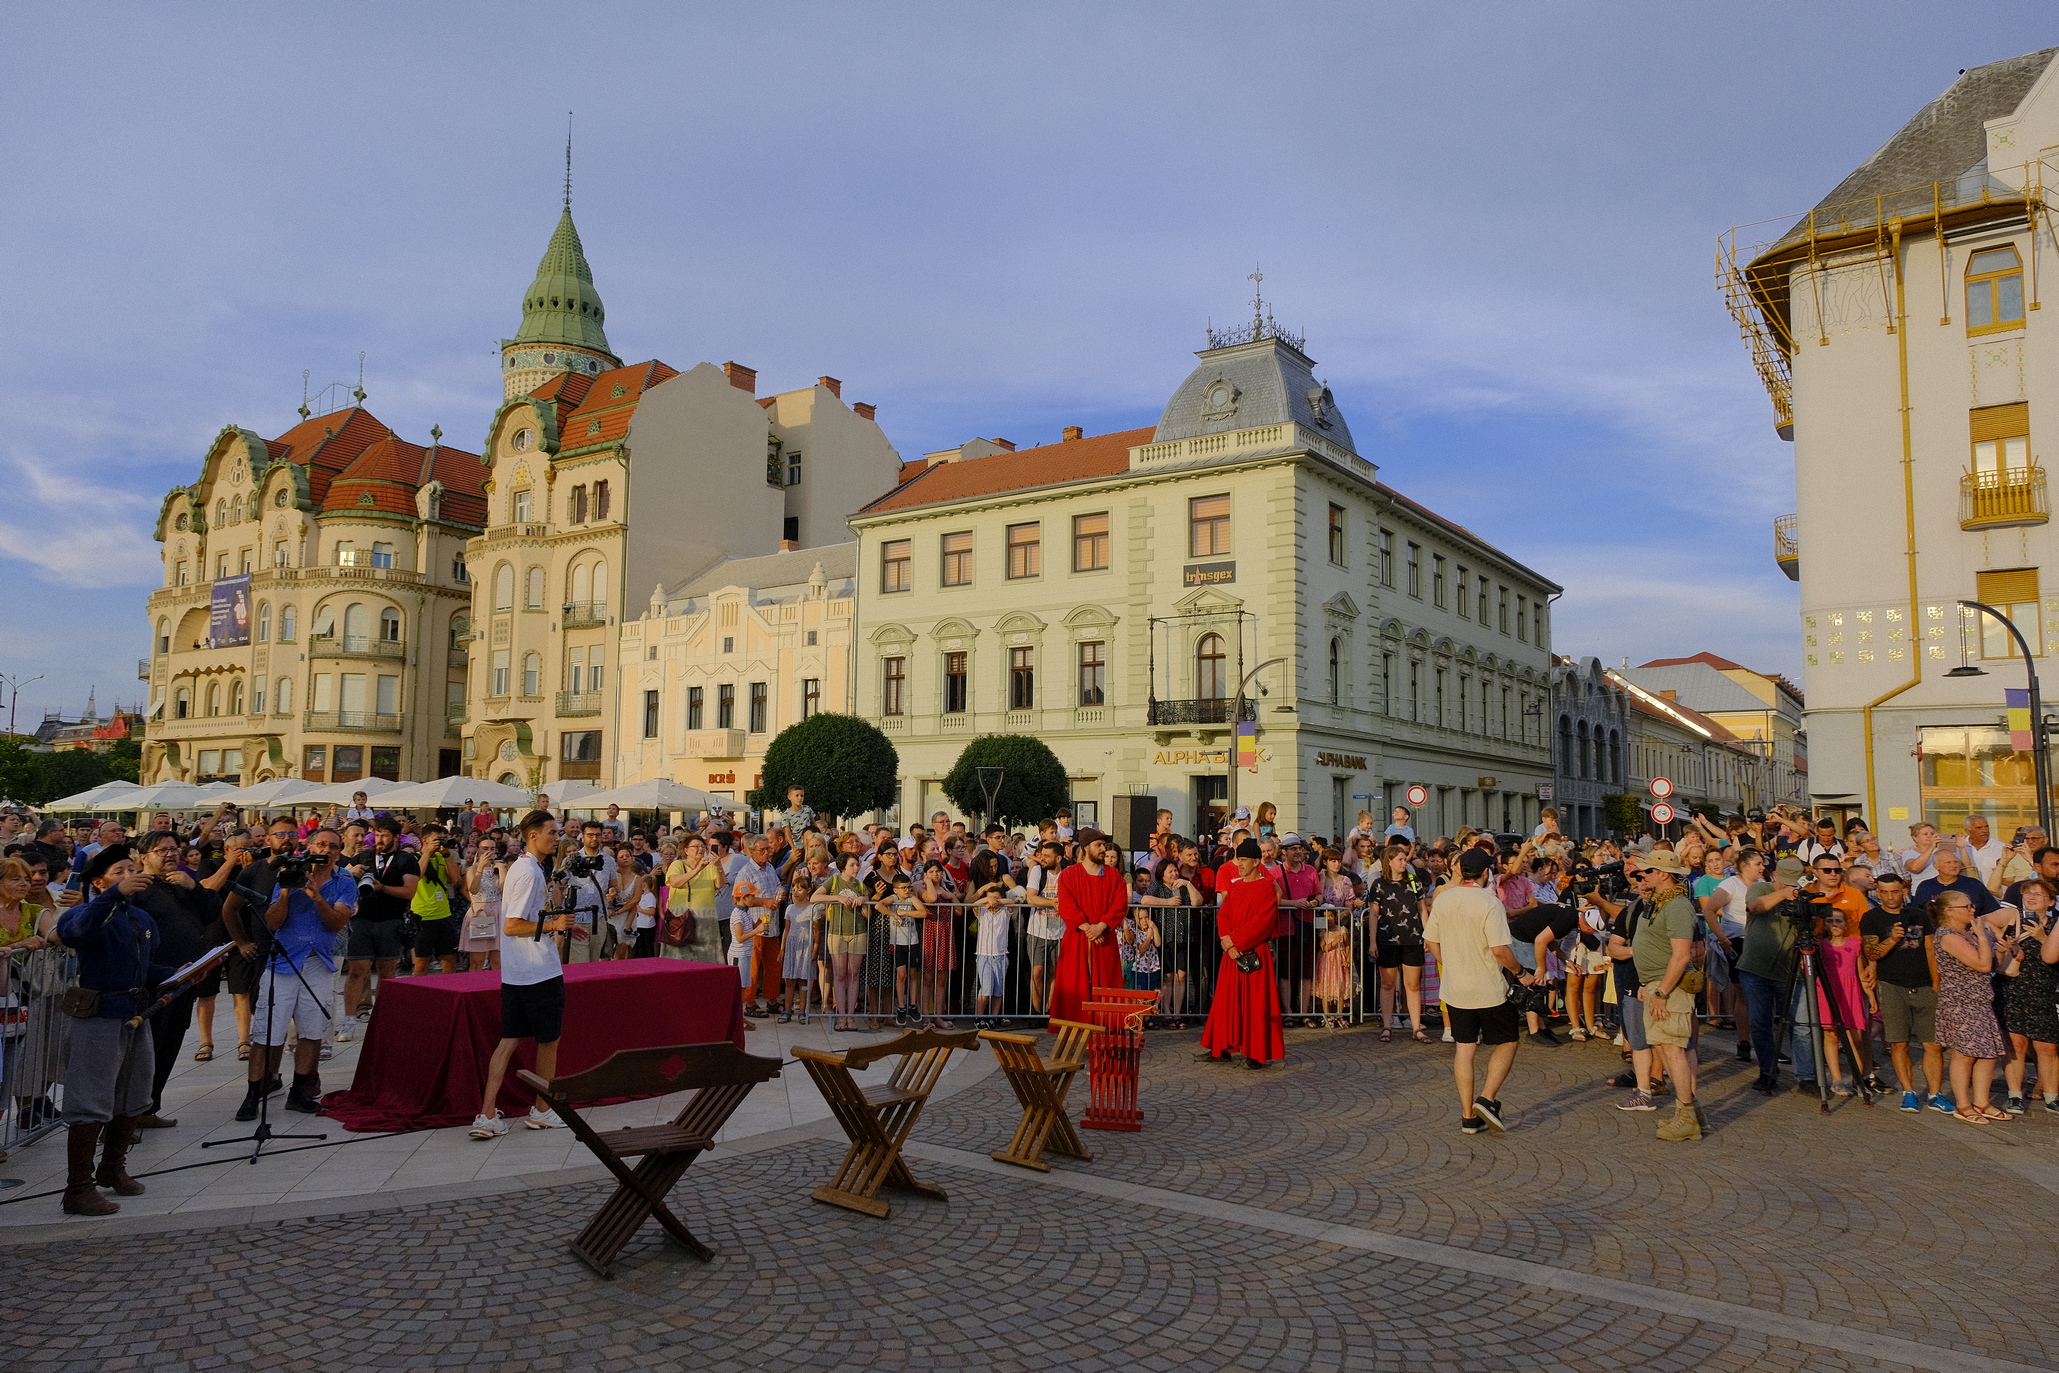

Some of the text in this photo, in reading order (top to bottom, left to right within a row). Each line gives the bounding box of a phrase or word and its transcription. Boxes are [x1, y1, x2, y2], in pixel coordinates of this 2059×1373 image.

[1153, 750, 1210, 765] ALPHA
[1316, 752, 1367, 770] ALPHA BANK
[708, 773, 726, 784] BCR
